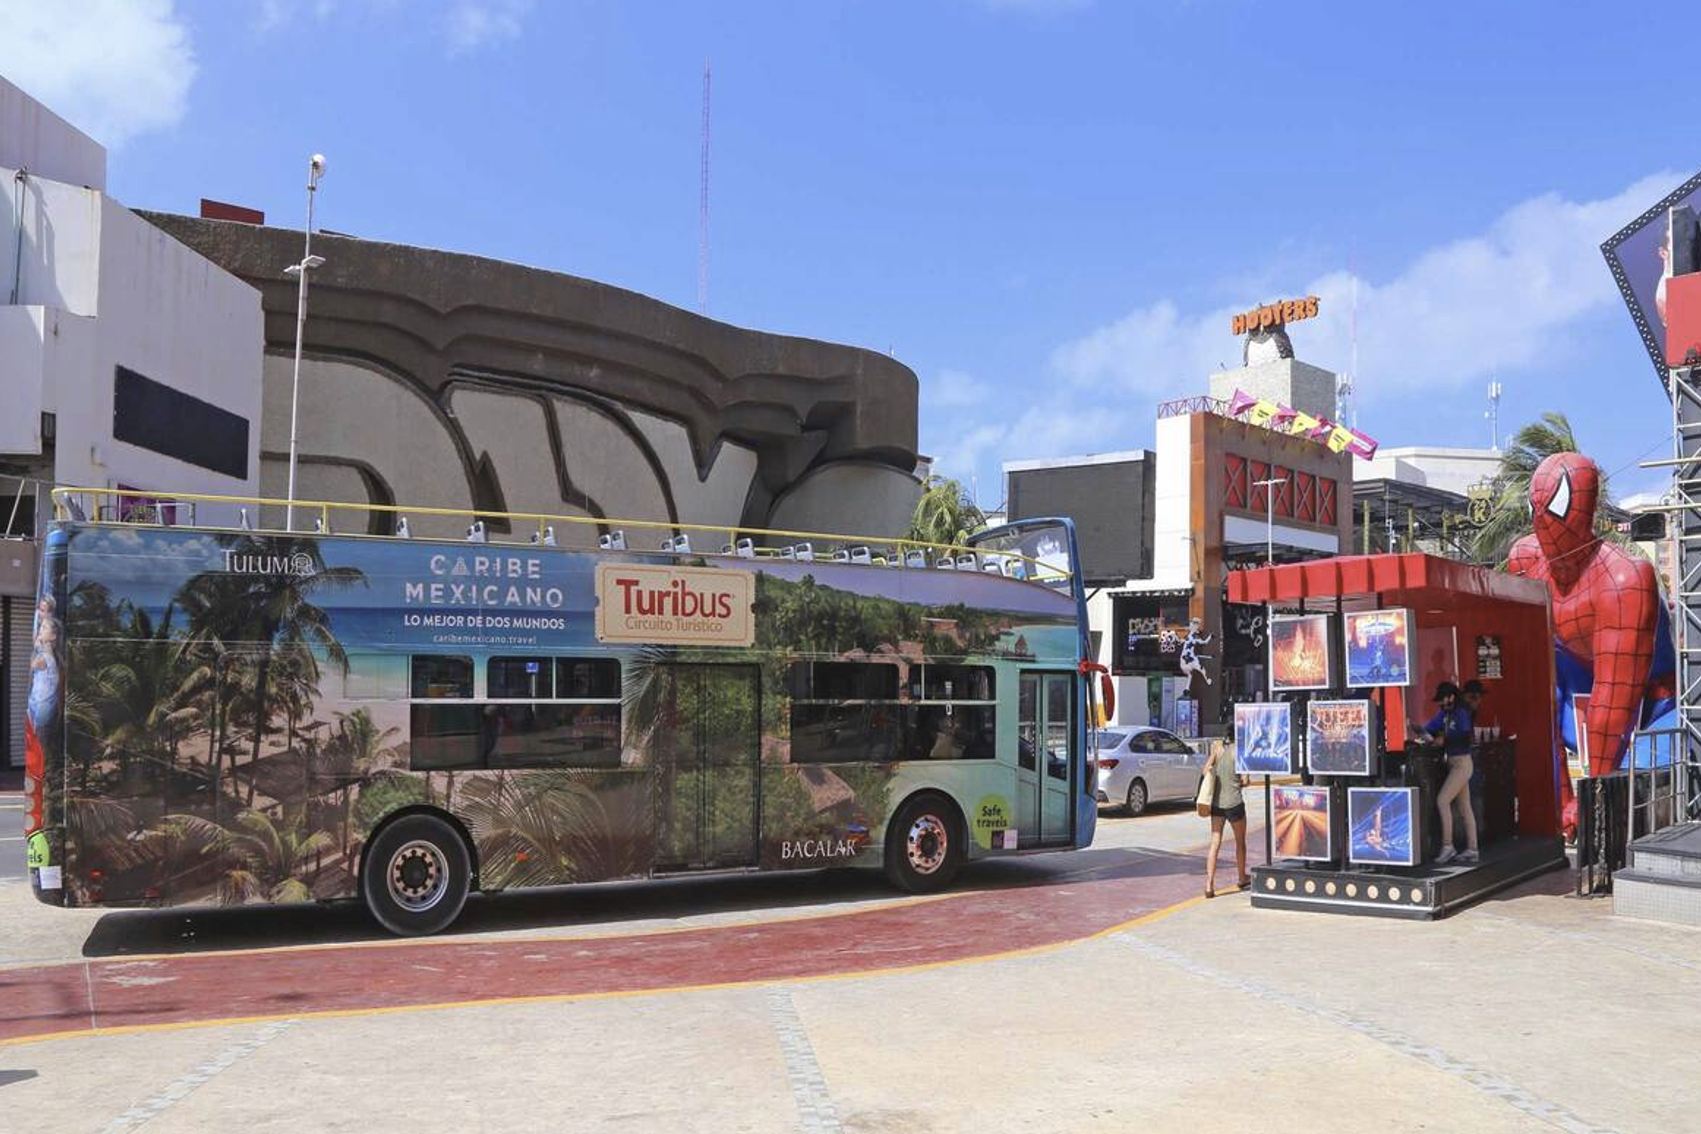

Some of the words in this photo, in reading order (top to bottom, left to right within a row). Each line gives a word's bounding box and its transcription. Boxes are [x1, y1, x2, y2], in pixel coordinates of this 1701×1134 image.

[1232, 296, 1319, 335] HOOTERS
[220, 549, 288, 574] TULUM
[430, 554, 541, 579] CARIBE
[405, 582, 564, 608] MEXICANO
[616, 579, 732, 618] Turibus
[404, 614, 420, 626] LO
[423, 616, 464, 628] MEJOR
[467, 616, 483, 628] DE
[486, 616, 511, 629] DOS
[512, 618, 566, 630] MUNDOS
[625, 616, 673, 631] Circuito
[432, 634, 538, 645] caribemexicano.travel
[982, 804, 1001, 817] Safe
[977, 816, 1008, 828] travels
[781, 839, 856, 859] BACALAR
